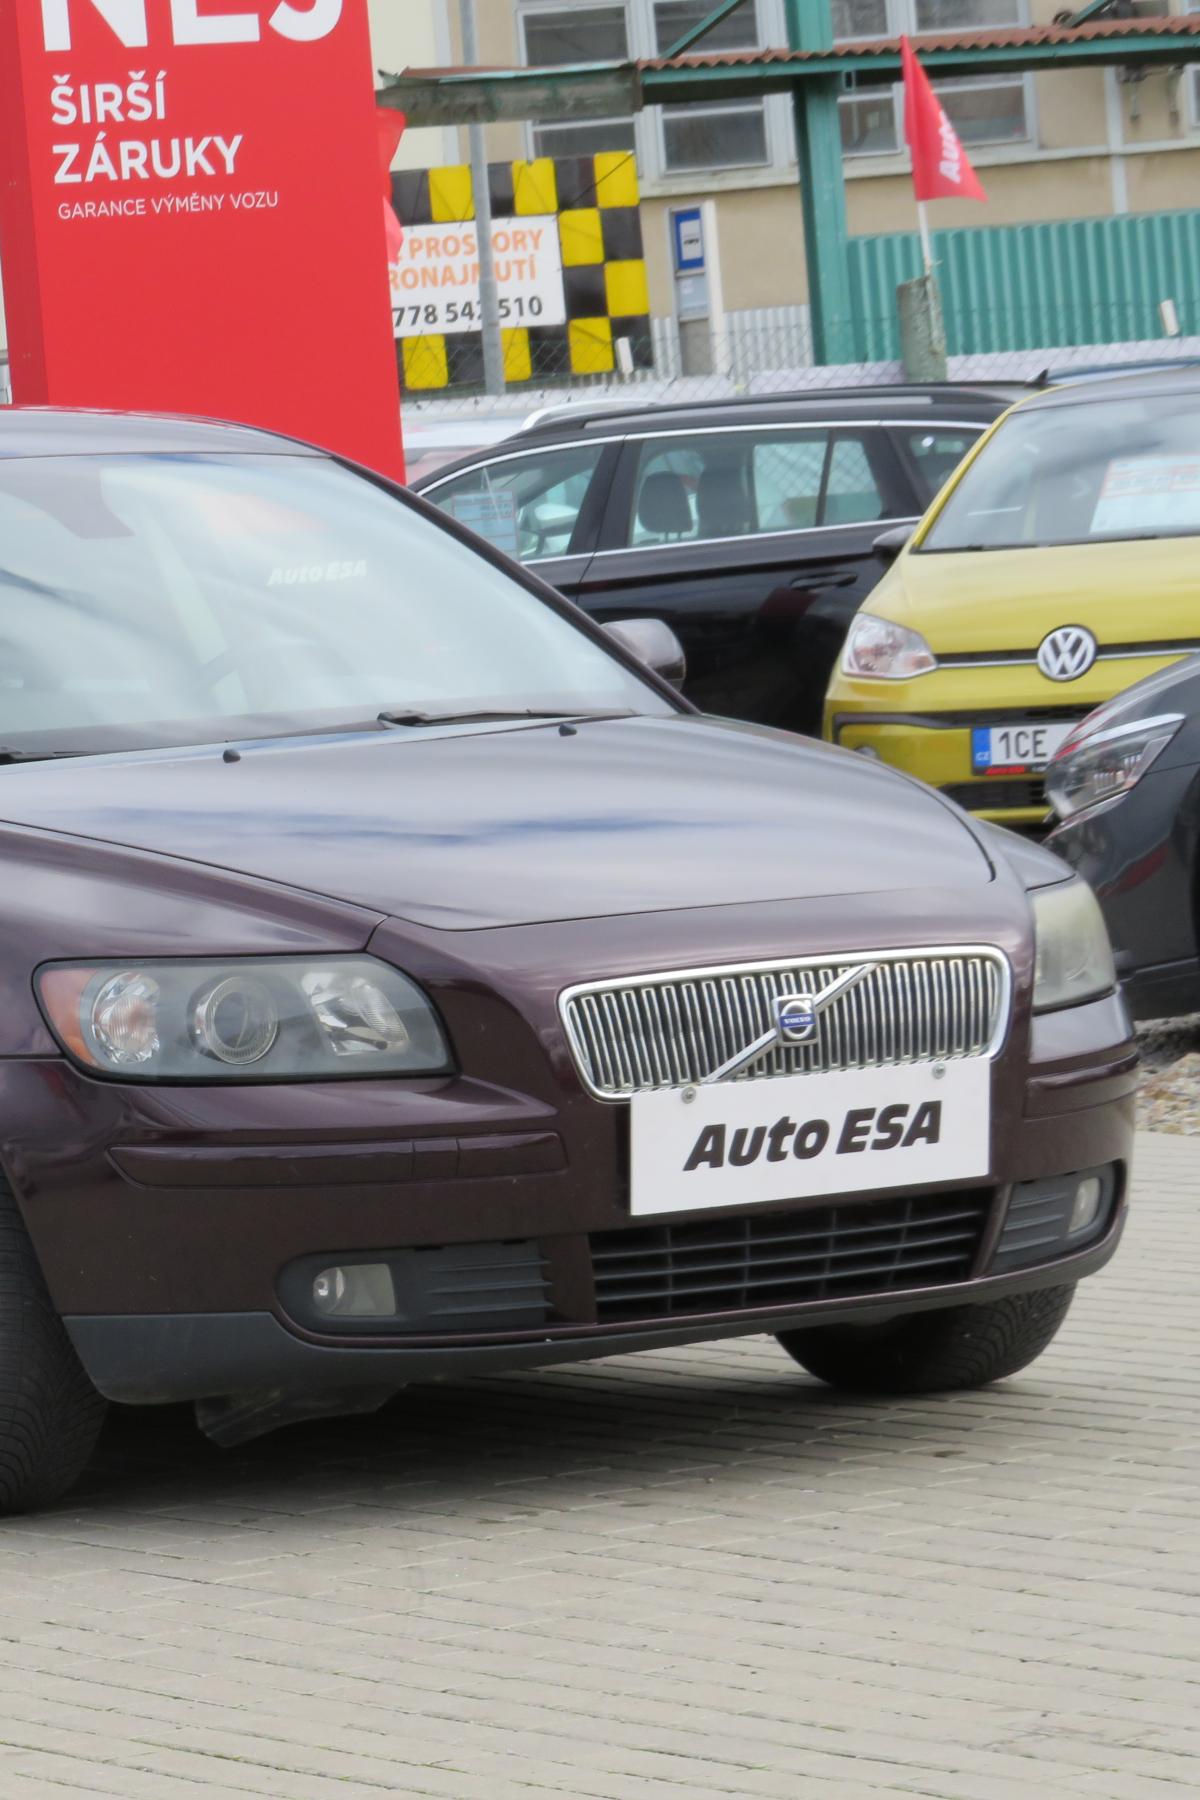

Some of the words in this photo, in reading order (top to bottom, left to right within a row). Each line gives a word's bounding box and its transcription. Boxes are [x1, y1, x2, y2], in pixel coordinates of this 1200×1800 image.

[50, 70, 167, 125] ŠIRŠÍ
[52, 131, 243, 184] ZÁRUKY
[58, 198, 146, 219] GARANCE
[151, 194, 225, 213] VÝMĚNY
[230, 192, 278, 208] VOZU
[409, 229, 543, 259] PROSORY
[392, 304, 437, 327] 778
[498, 296, 543, 318] 510
[267, 567, 322, 587] Auto
[325, 560, 368, 581] ESA
[999, 729, 1048, 759] 1CE
[683, 1116, 829, 1171] Auto
[836, 1100, 942, 1154] ESA
